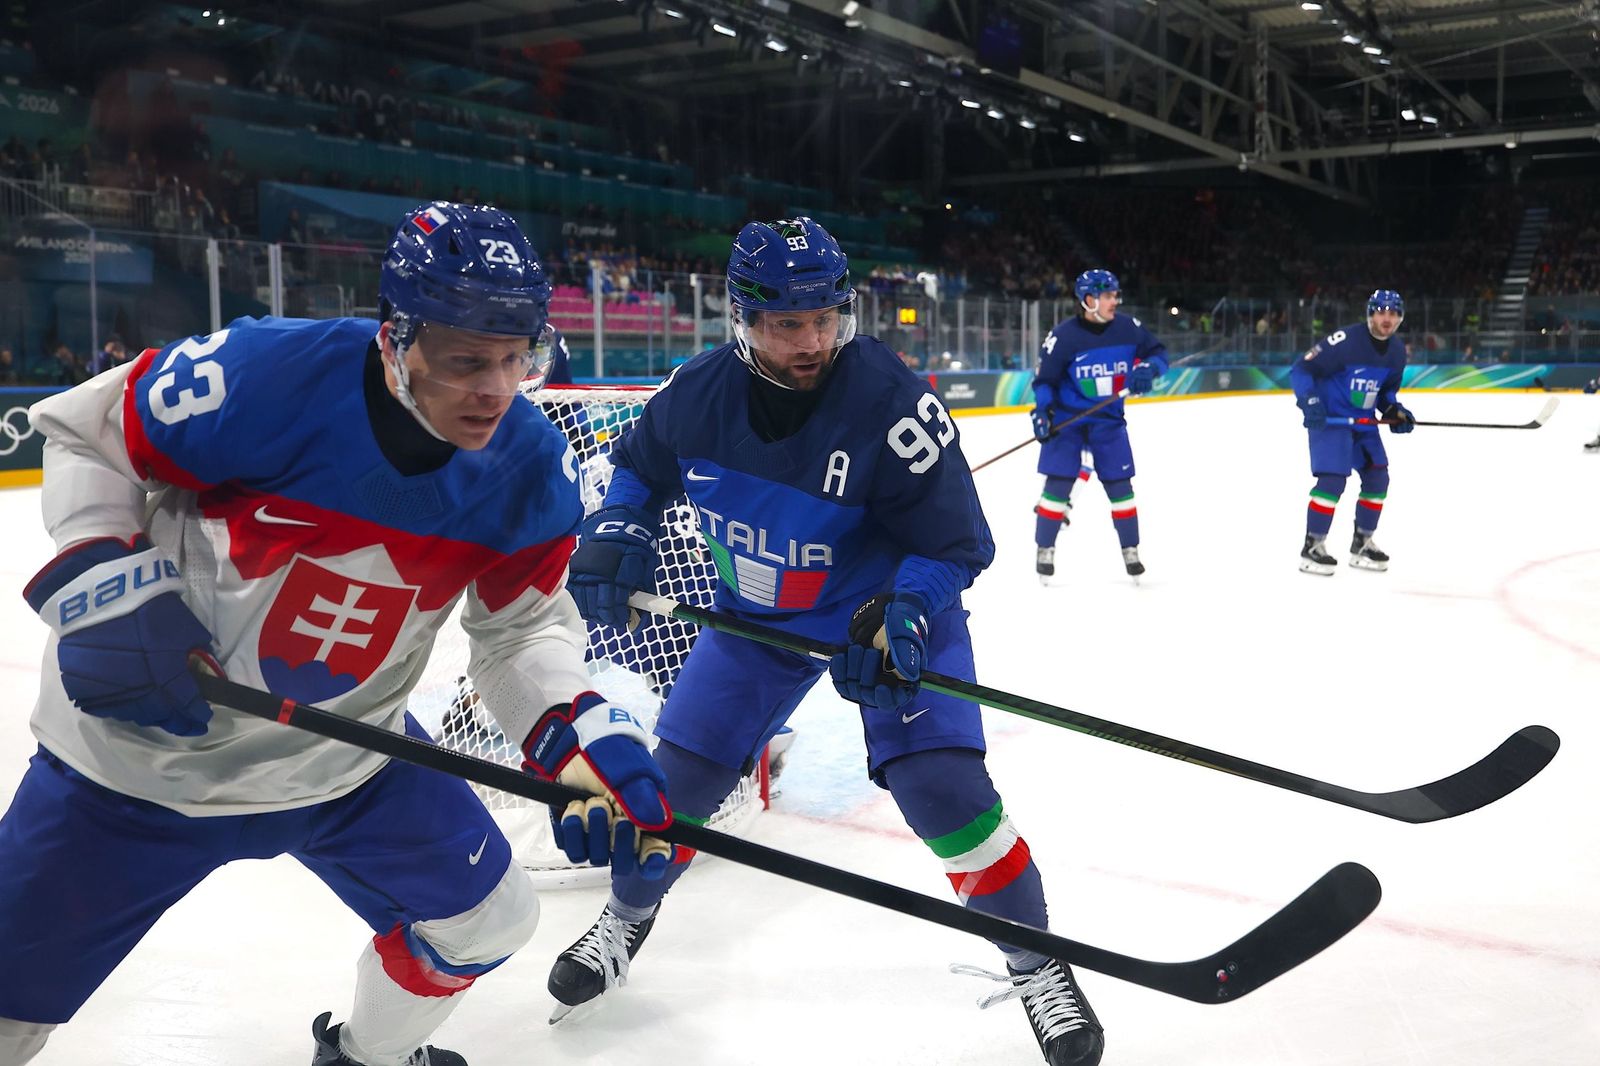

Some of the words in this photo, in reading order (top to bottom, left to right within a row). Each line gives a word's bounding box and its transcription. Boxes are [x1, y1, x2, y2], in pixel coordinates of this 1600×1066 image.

[17, 93, 60, 115] 2026
[479, 238, 520, 265] 23
[786, 235, 809, 251] 93
[148, 329, 231, 426] 23
[1076, 361, 1128, 379] ITALIA
[887, 392, 955, 474] 93
[822, 449, 850, 497] A
